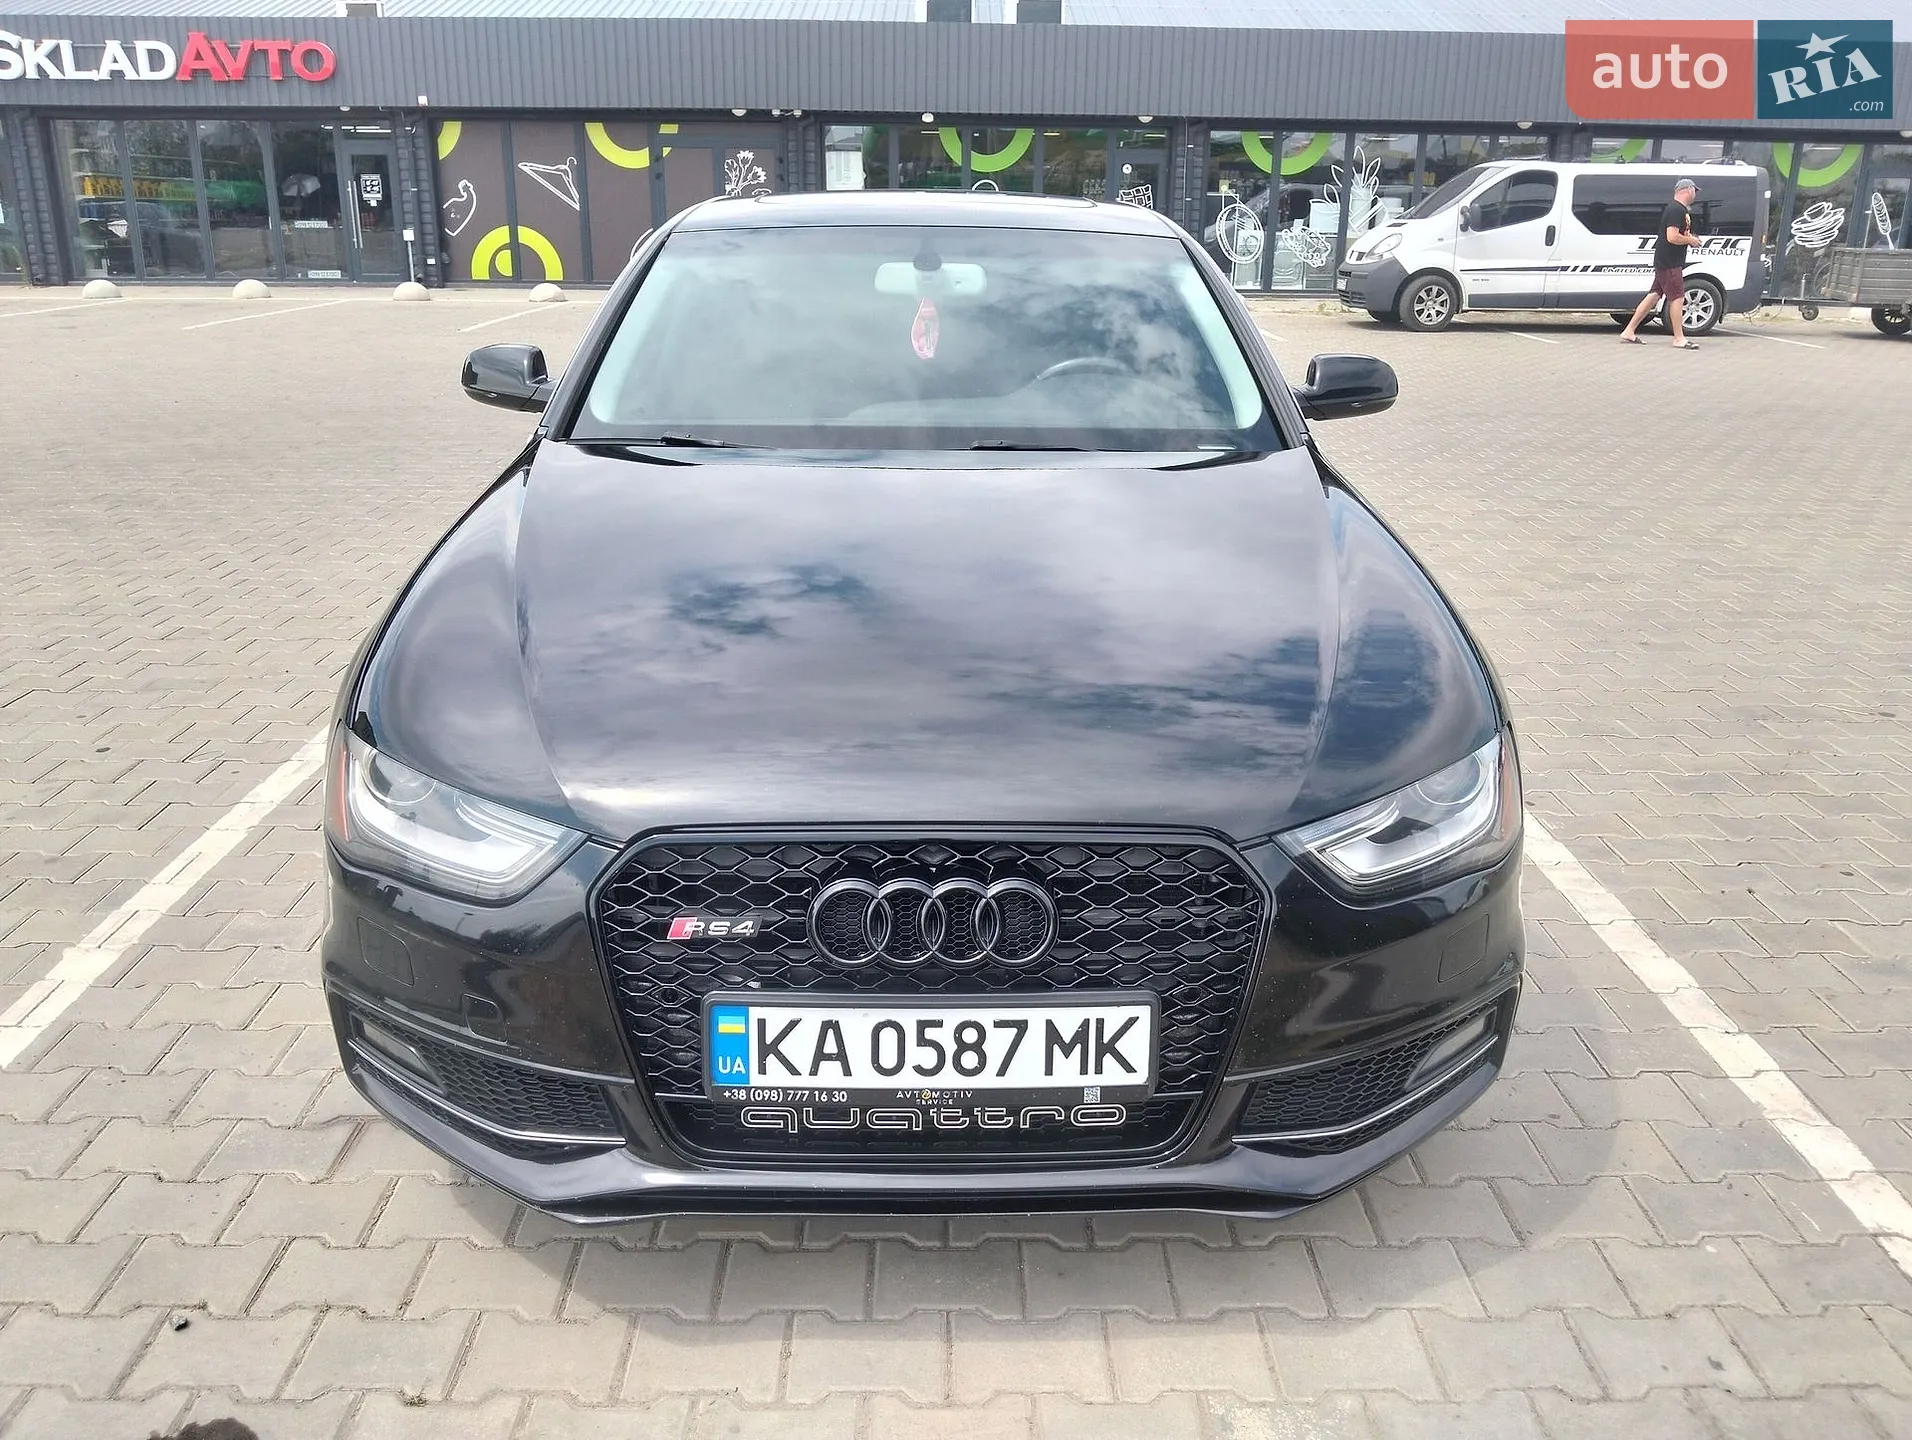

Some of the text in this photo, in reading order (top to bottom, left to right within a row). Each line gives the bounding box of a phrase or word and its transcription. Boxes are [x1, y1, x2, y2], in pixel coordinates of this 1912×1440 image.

[1691, 248, 1746, 256] RENAULT
[683, 920, 755, 936] RS4
[757, 1016, 1140, 1078] KA 0587 MK
[717, 1055, 746, 1075] UA
[723, 1088, 848, 1102] +38 (098) 777 16 30
[740, 1104, 1127, 1133] quattro
